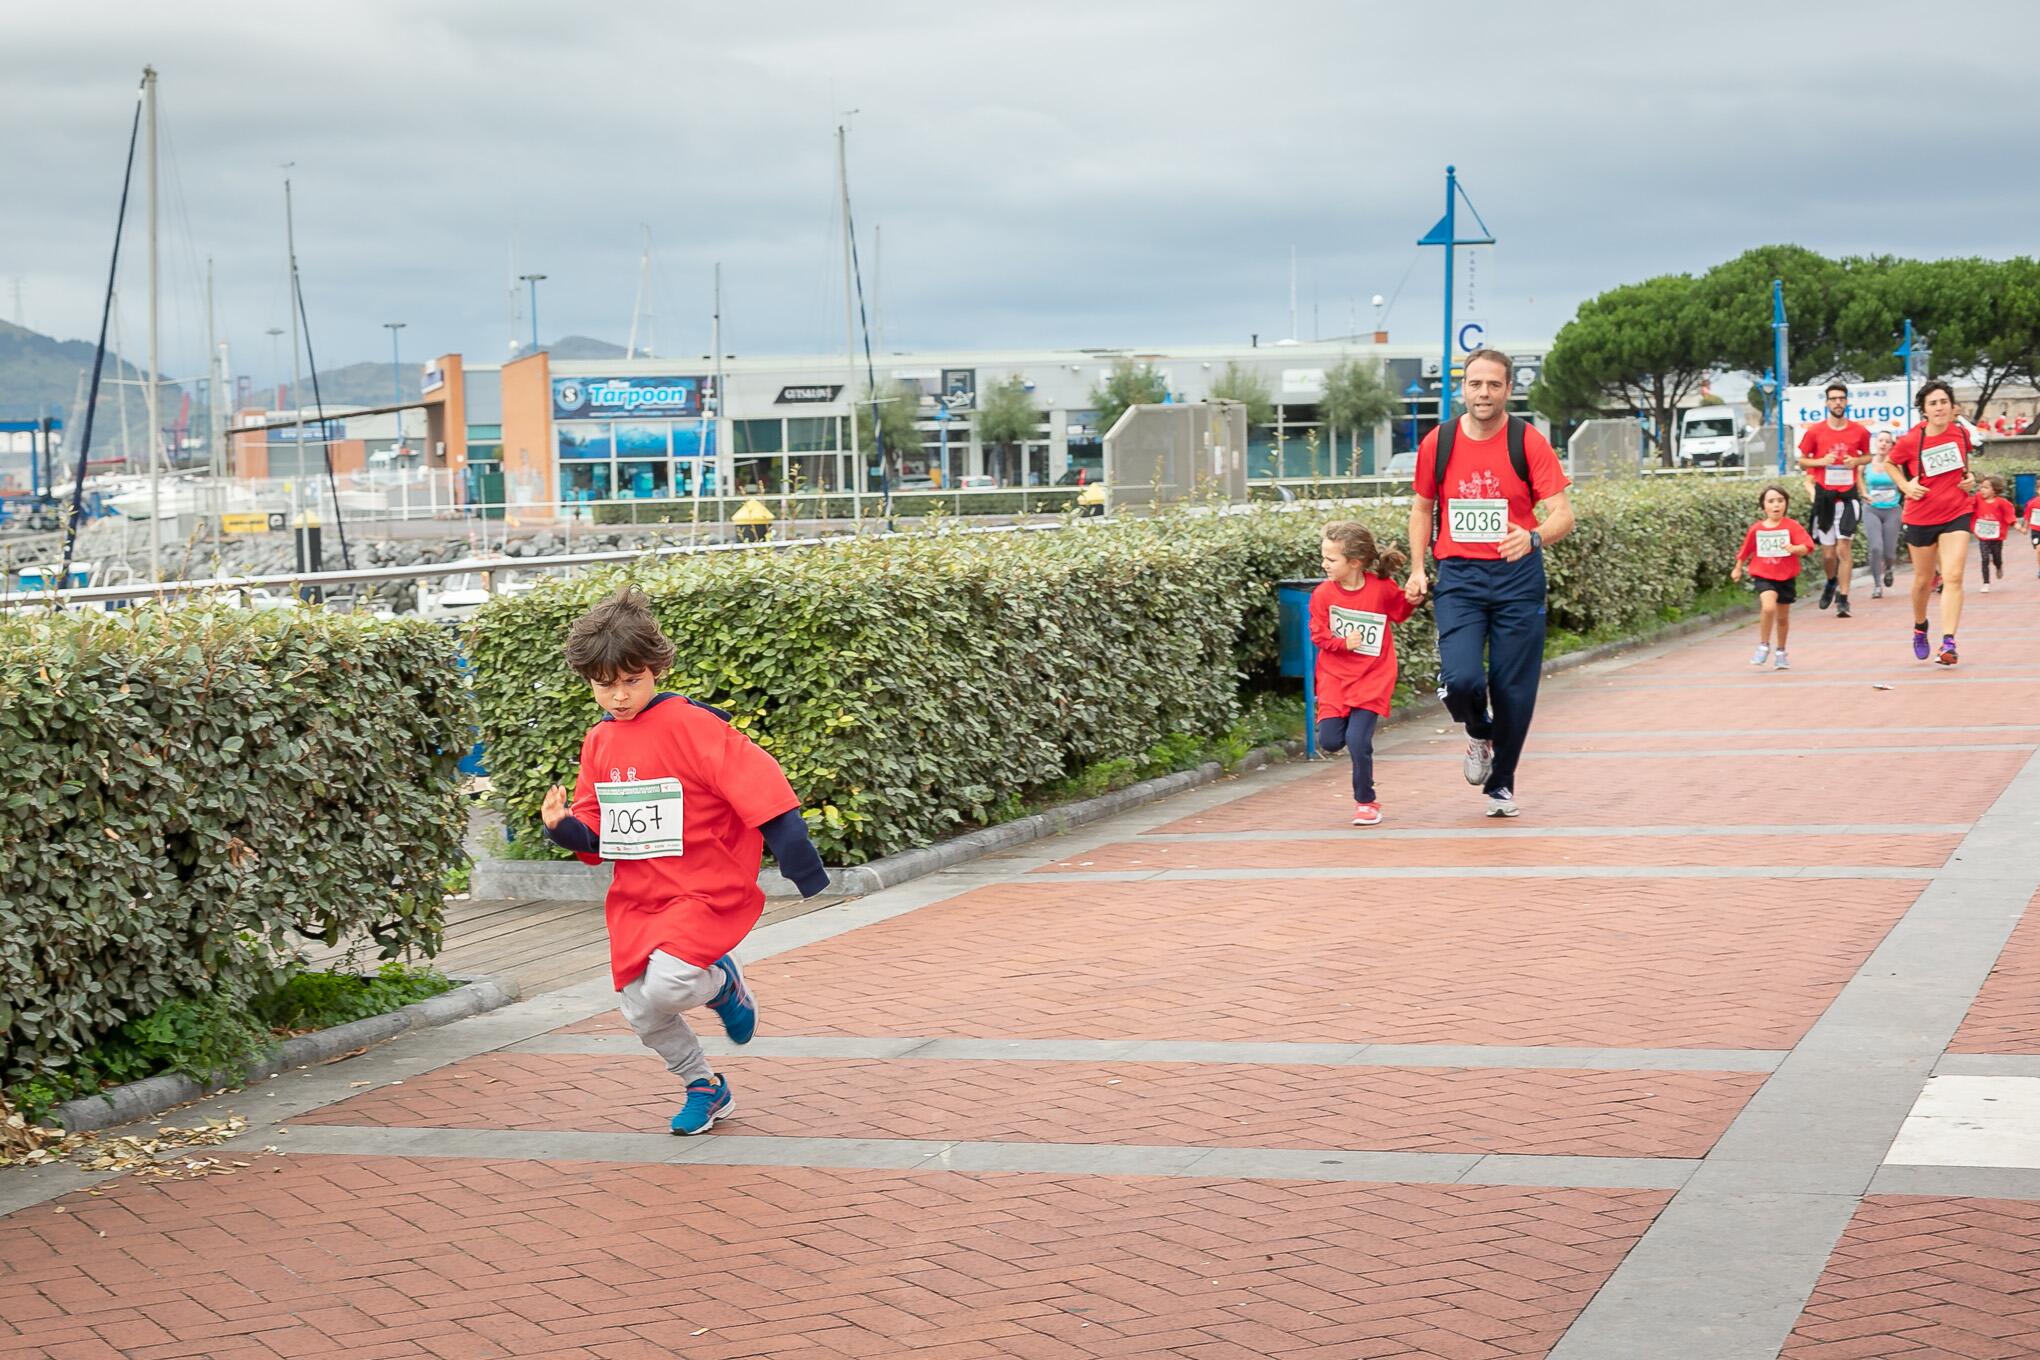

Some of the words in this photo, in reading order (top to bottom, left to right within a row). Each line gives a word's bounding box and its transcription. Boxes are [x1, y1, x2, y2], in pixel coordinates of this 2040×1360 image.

[1459, 323, 1484, 352] C
[590, 385, 685, 409] Tarpoon
[1800, 404, 1905, 422] telfurgo
[1454, 511, 1502, 531] 2036
[608, 804, 663, 835] 2067
